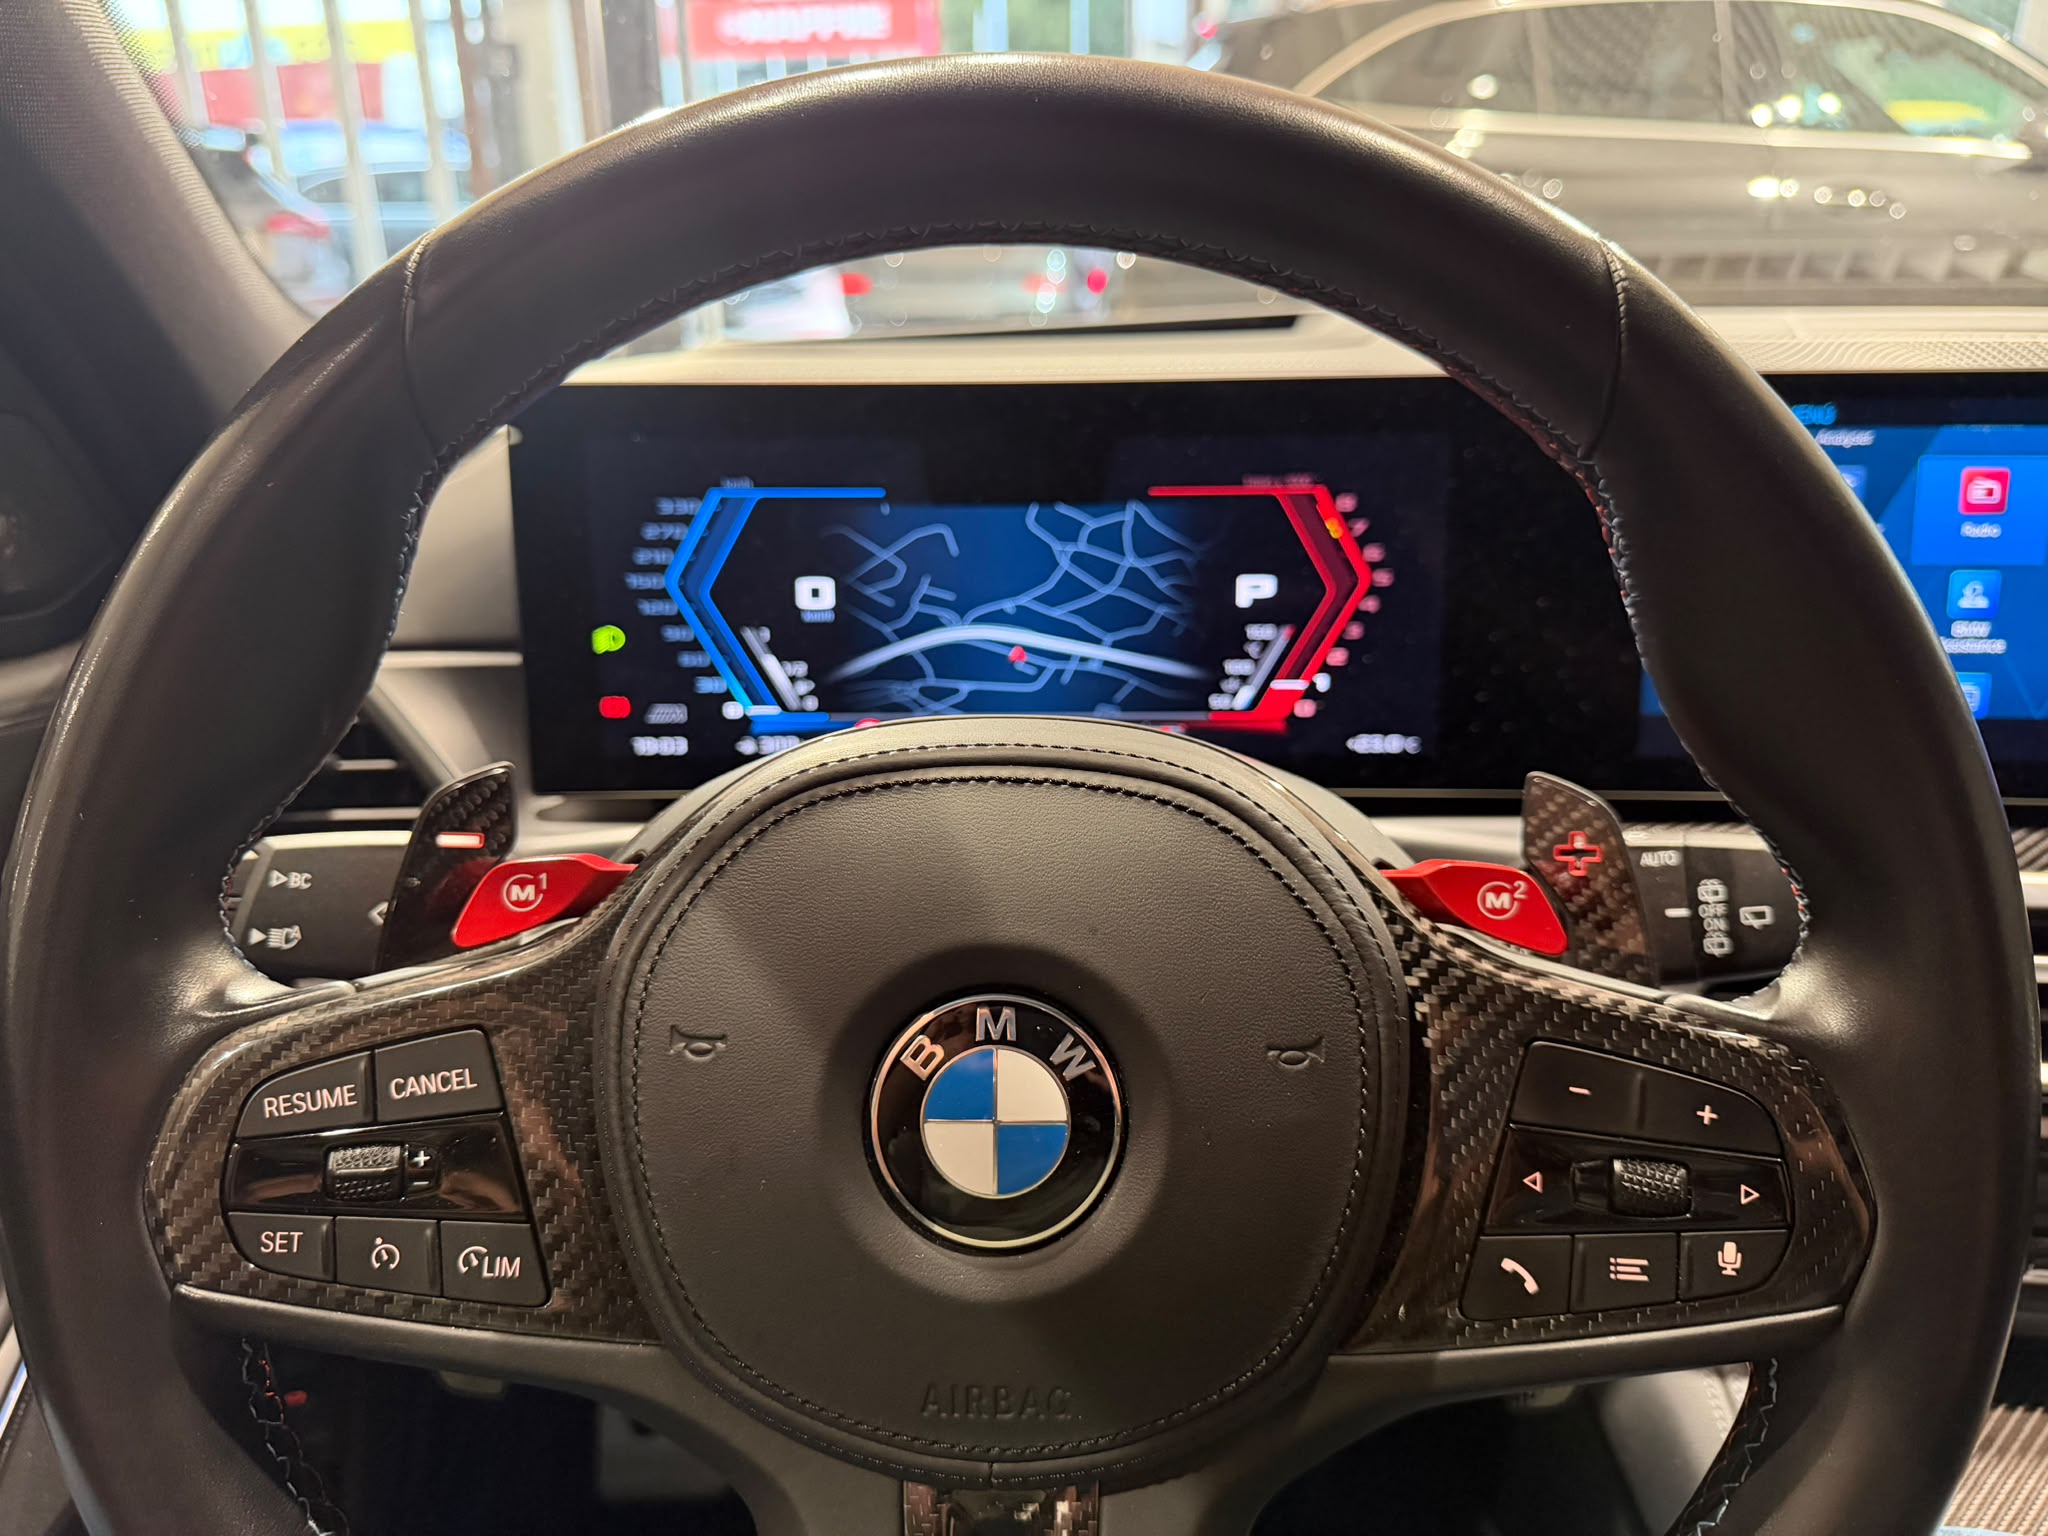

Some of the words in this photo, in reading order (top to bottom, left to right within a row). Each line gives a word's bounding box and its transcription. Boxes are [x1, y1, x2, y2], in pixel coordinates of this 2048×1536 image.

[1235, 573, 1278, 608] P
[1640, 849, 1681, 867] AUTO
[286, 872, 313, 890] BC
[1698, 903, 1729, 918] OFF
[1703, 917, 1730, 932] ON
[900, 1006, 1097, 1082] BMW
[390, 1067, 478, 1100] CANCEL
[263, 1084, 358, 1119] RESUME
[260, 1230, 303, 1254] SET
[481, 1256, 521, 1279] LIM
[920, 1382, 1073, 1421] AIRBAG
